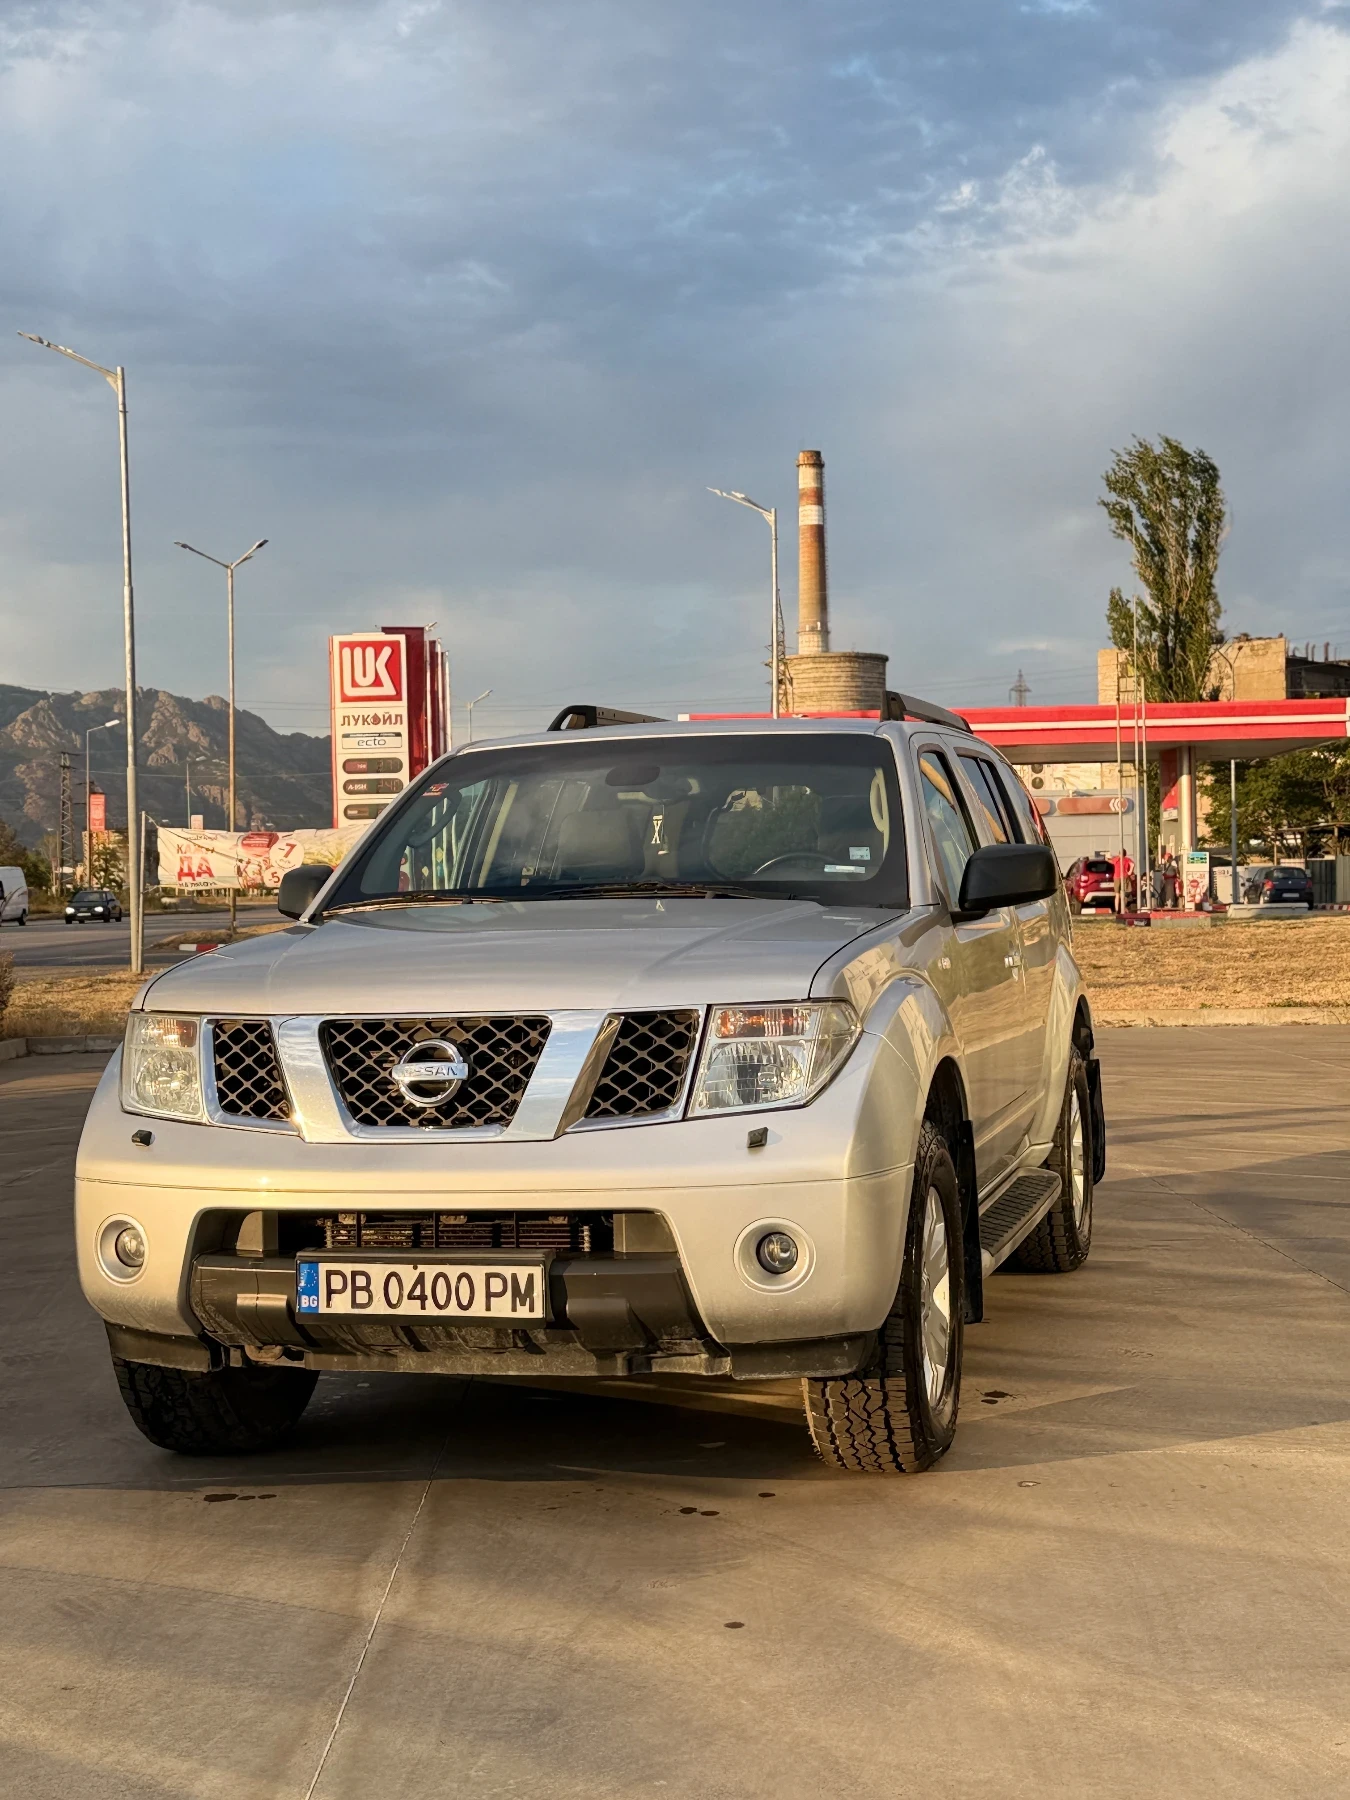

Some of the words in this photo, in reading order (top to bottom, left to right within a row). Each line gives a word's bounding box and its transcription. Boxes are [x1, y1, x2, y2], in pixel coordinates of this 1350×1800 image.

[357, 737, 387, 747] ecto
[177, 855, 215, 882] ДА
[300, 1295, 318, 1308] BG
[325, 1269, 374, 1310] PB
[383, 1271, 475, 1311] 0400
[484, 1271, 535, 1313] PM
